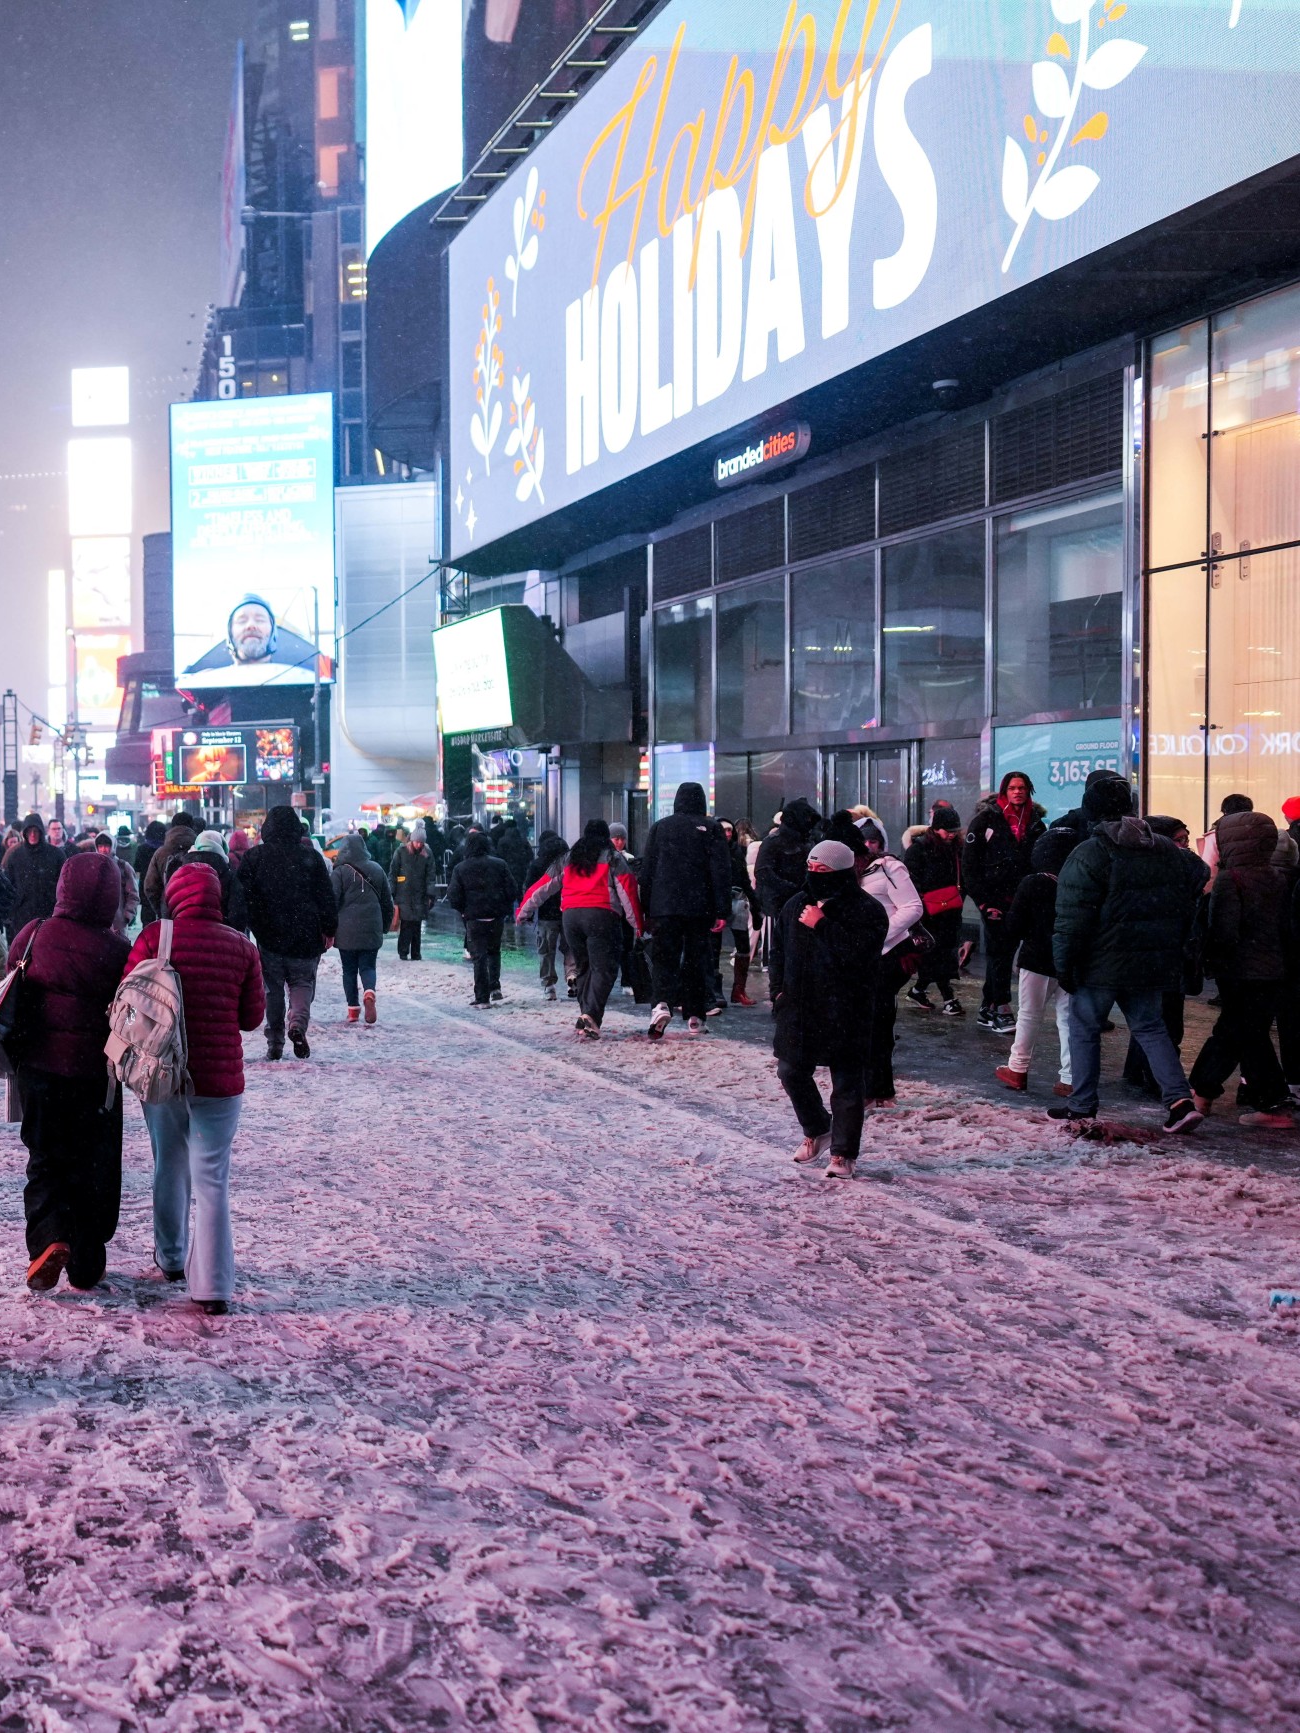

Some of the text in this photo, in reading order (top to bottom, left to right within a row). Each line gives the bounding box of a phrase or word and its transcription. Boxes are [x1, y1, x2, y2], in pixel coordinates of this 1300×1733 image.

[576, 0, 901, 292] Happy
[565, 22, 938, 476] HOLIDAYS
[218, 334, 236, 399] 150
[717, 431, 797, 481] brandedcities
[1050, 760, 1091, 786] 3,163
[1075, 741, 1119, 751] GROUND FLOOR
